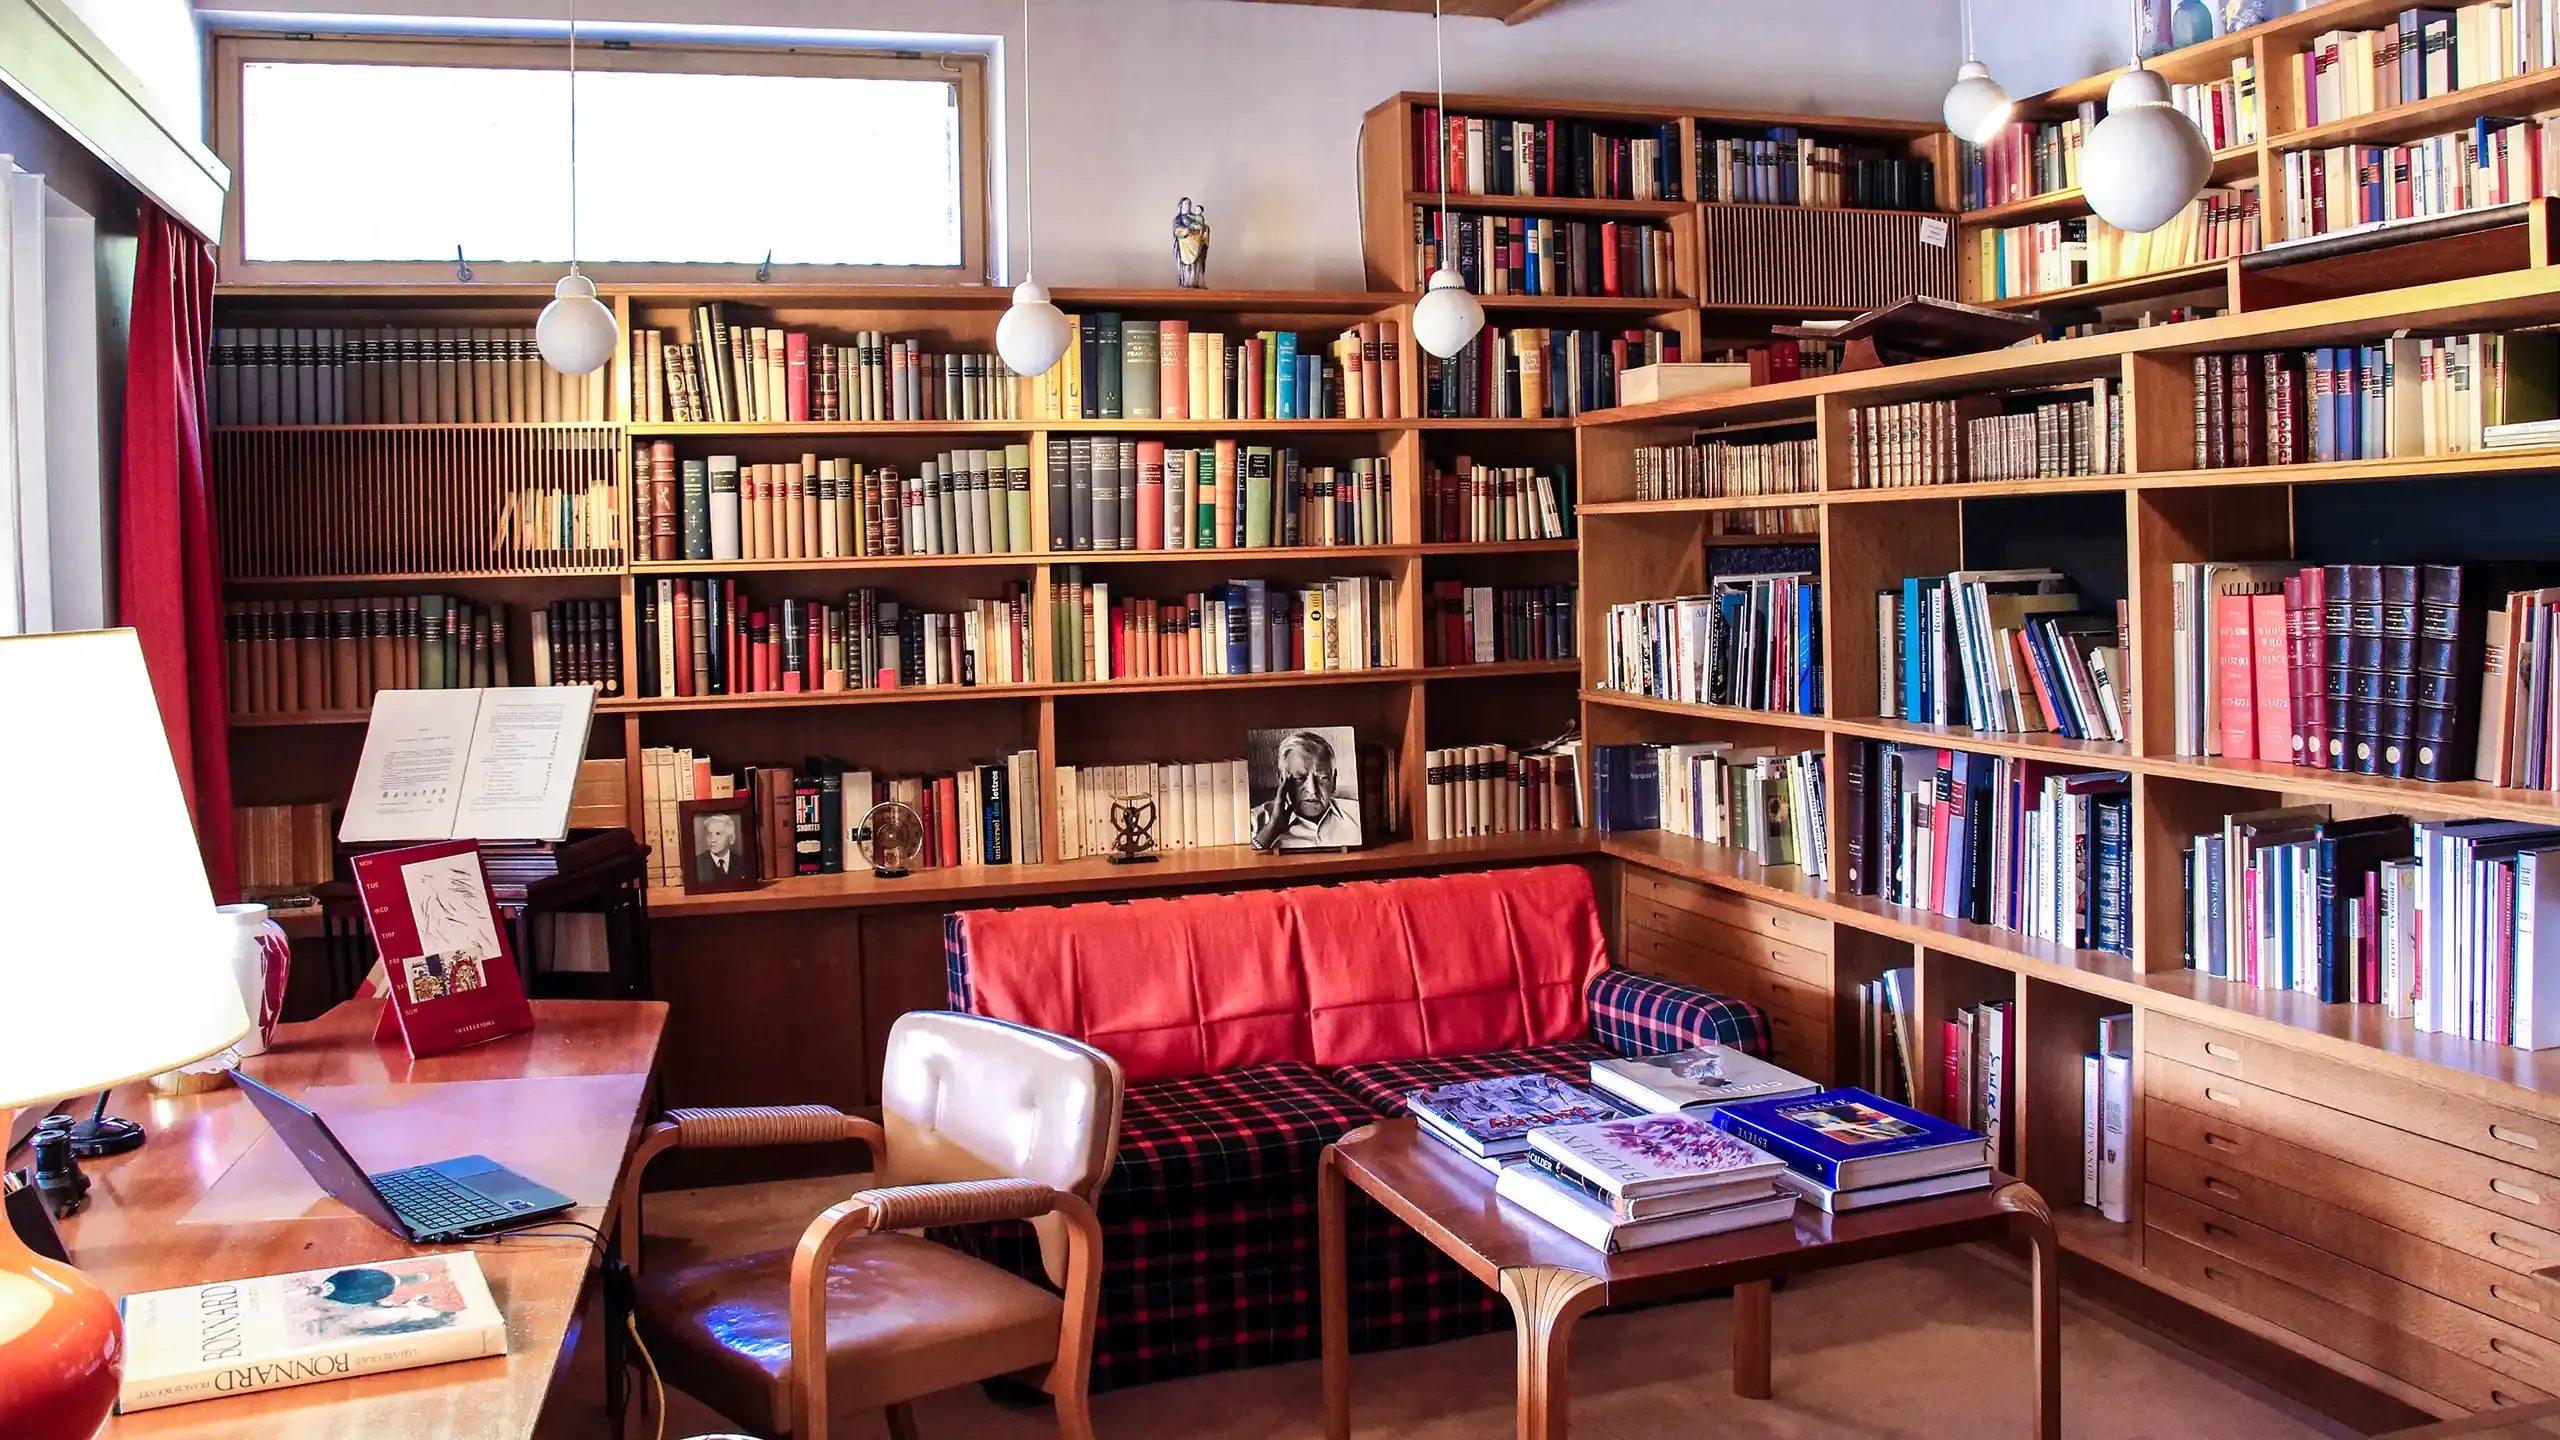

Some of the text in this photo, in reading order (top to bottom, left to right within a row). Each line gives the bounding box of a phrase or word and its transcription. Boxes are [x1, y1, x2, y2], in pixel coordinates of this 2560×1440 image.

[990, 770, 999, 800] lettres
[796, 823, 821, 833] SHORTER
[985, 807, 993, 862] dictionnaire
[993, 819, 1001, 861] universel
[358, 859, 373, 868] MON
[366, 882, 379, 890] TUE
[2211, 880, 2219, 918] PICASSO
[373, 906, 389, 915] WED
[381, 931, 395, 940] THU
[389, 958, 400, 966] FRI
[404, 1007, 418, 1017] SUN
[454, 1019, 496, 1035] INVITATIONS
[1694, 1079, 1784, 1098] CHANEL
[1530, 1152, 1553, 1172] CALDER
[1544, 1127, 1649, 1182] BAZAINE
[2086, 1122, 2096, 1182] BONNARD
[201, 1284, 243, 1363] BONNARD
[214, 1351, 350, 1393] BONNARD
[137, 1380, 210, 1400] FRANCIS BOUVET
